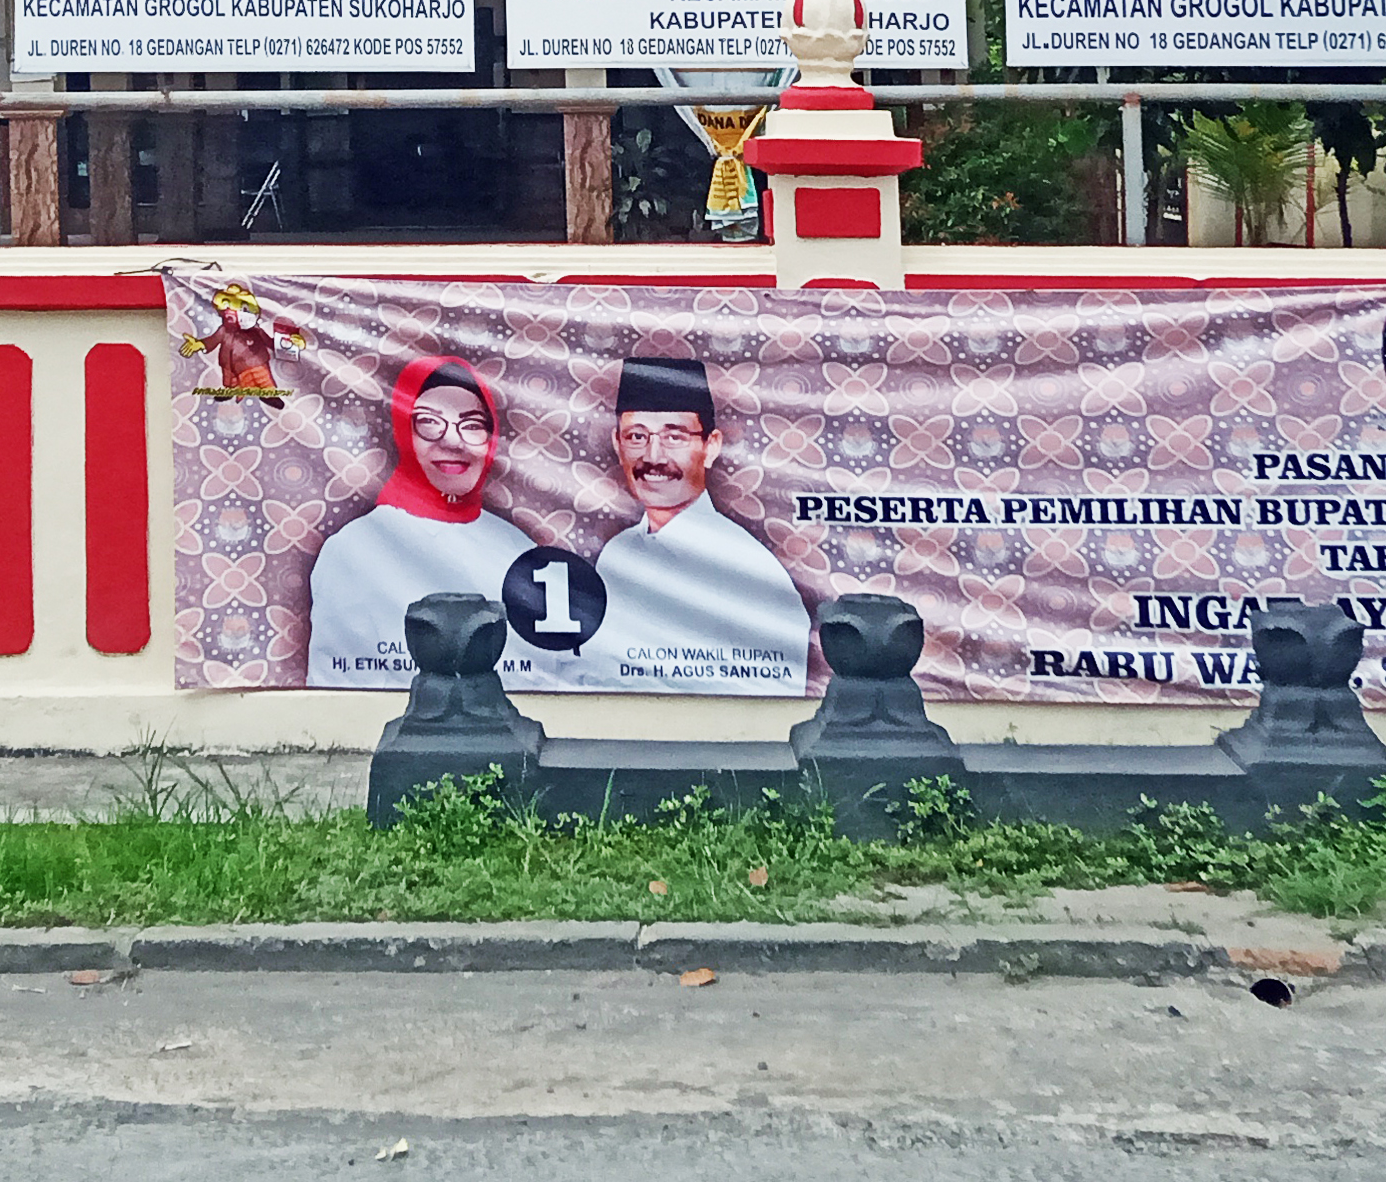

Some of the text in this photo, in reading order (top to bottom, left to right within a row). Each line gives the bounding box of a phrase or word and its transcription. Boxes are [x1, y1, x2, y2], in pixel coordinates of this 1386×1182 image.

[650, 10, 784, 31] KABUPATE
[50, 39, 97, 57] DUREN
[128, 39, 143, 56] 18
[146, 38, 223, 56] GEDANGAN
[226, 38, 261, 56] TELP
[264, 36, 302, 57] (0271)
[306, 38, 350, 56] 626472
[353, 38, 392, 55] KODE
[395, 37, 423, 55] POS
[426, 38, 463, 55] 57552
[519, 39, 539, 56] JL.
[542, 38, 589, 56] DUREN
[620, 38, 634, 55] 18
[638, 37, 715, 56] GEDANGAN
[718, 38, 752, 56] TELP
[887, 38, 915, 56] POS
[919, 39, 956, 57] 57552
[1115, 31, 1140, 50] NO
[1149, 32, 1168, 50] 18
[1173, 31, 1271, 50] GEDANGAN
[1274, 32, 1319, 50] TELP
[1323, 30, 1372, 52] (0271)
[795, 496, 988, 524] PESERTA
[1000, 498, 1243, 525] PEMILIHAN
[531, 561, 582, 634] 1
[355, 657, 389, 671] ETIK
[626, 647, 785, 663] CALON WAKIL BUPATI
[671, 665, 715, 678] AGUS
[719, 665, 793, 679] SANTOSA
[1029, 649, 1177, 685] RABU
